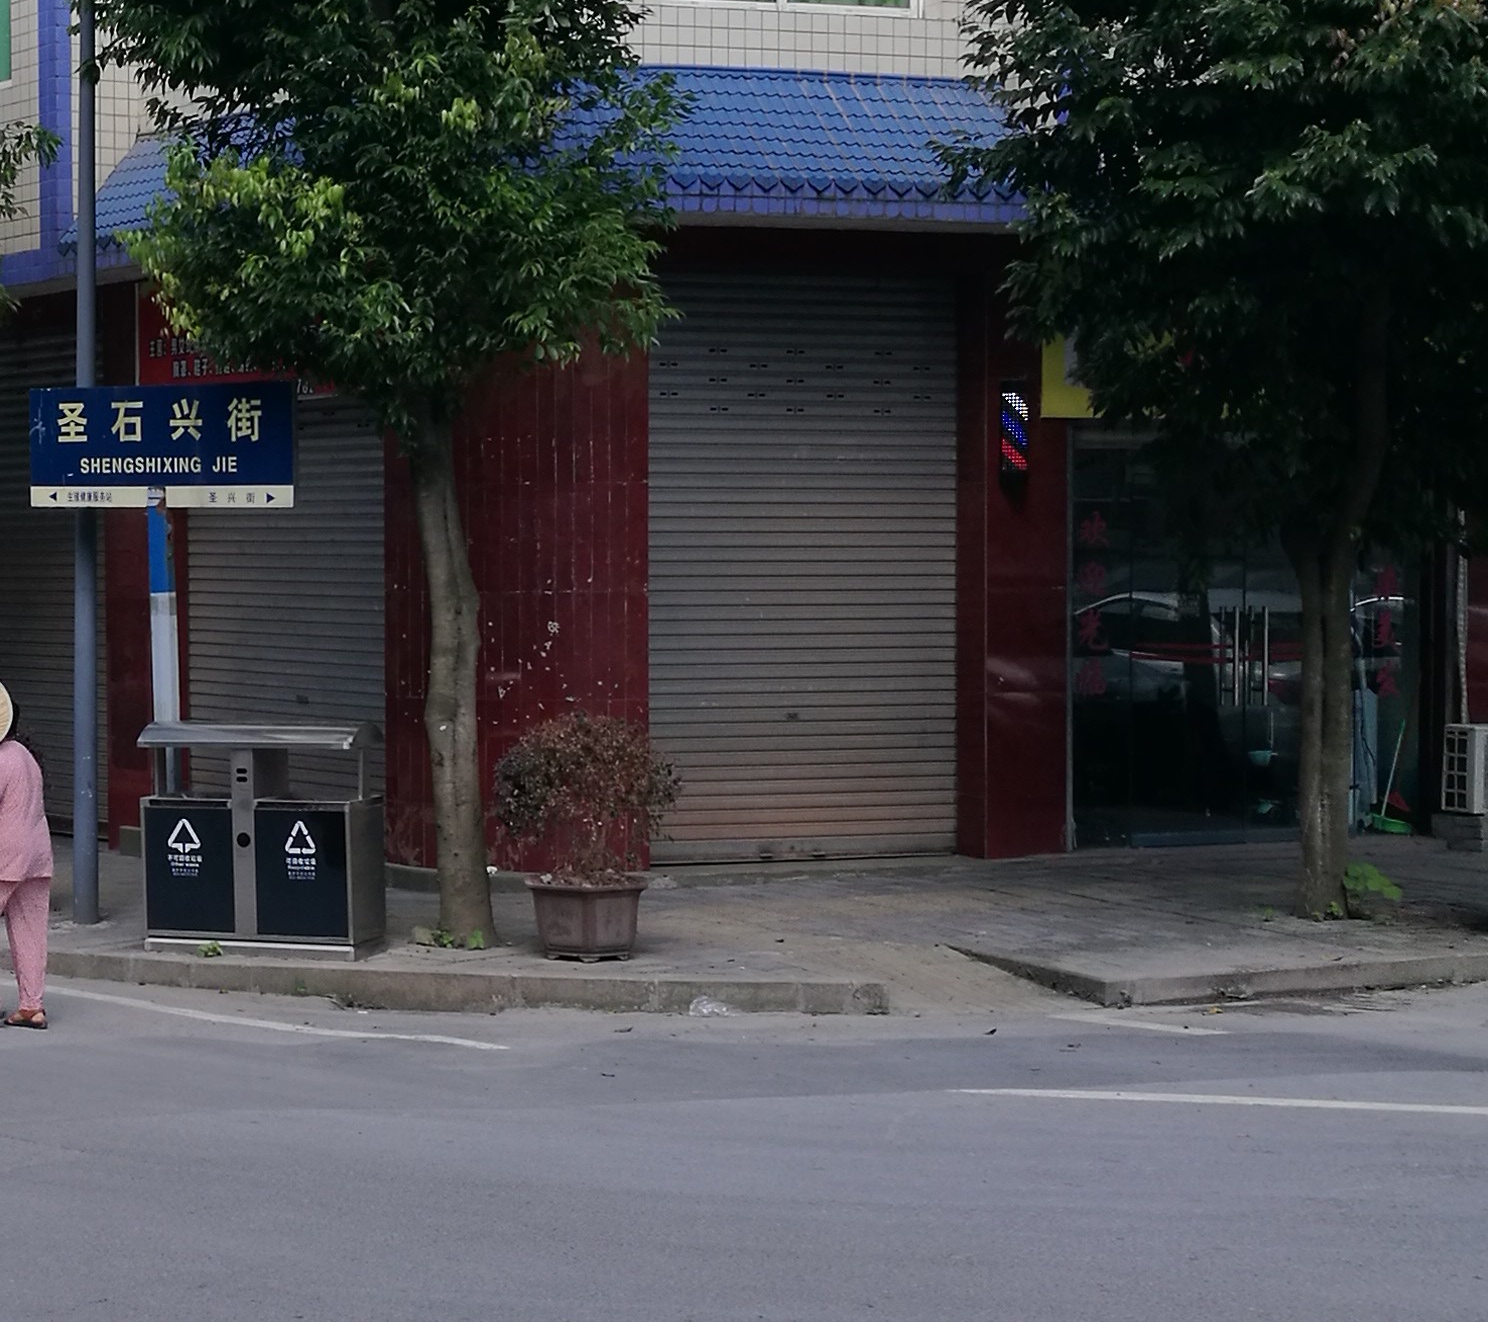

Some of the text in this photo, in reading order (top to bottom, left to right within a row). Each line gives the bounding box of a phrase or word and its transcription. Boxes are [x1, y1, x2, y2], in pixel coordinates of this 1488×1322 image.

[57, 397, 262, 444] 圣石兴街
[80, 456, 238, 474] SHENGSHIXING JIE
[208, 492, 256, 504] 圣兴街
